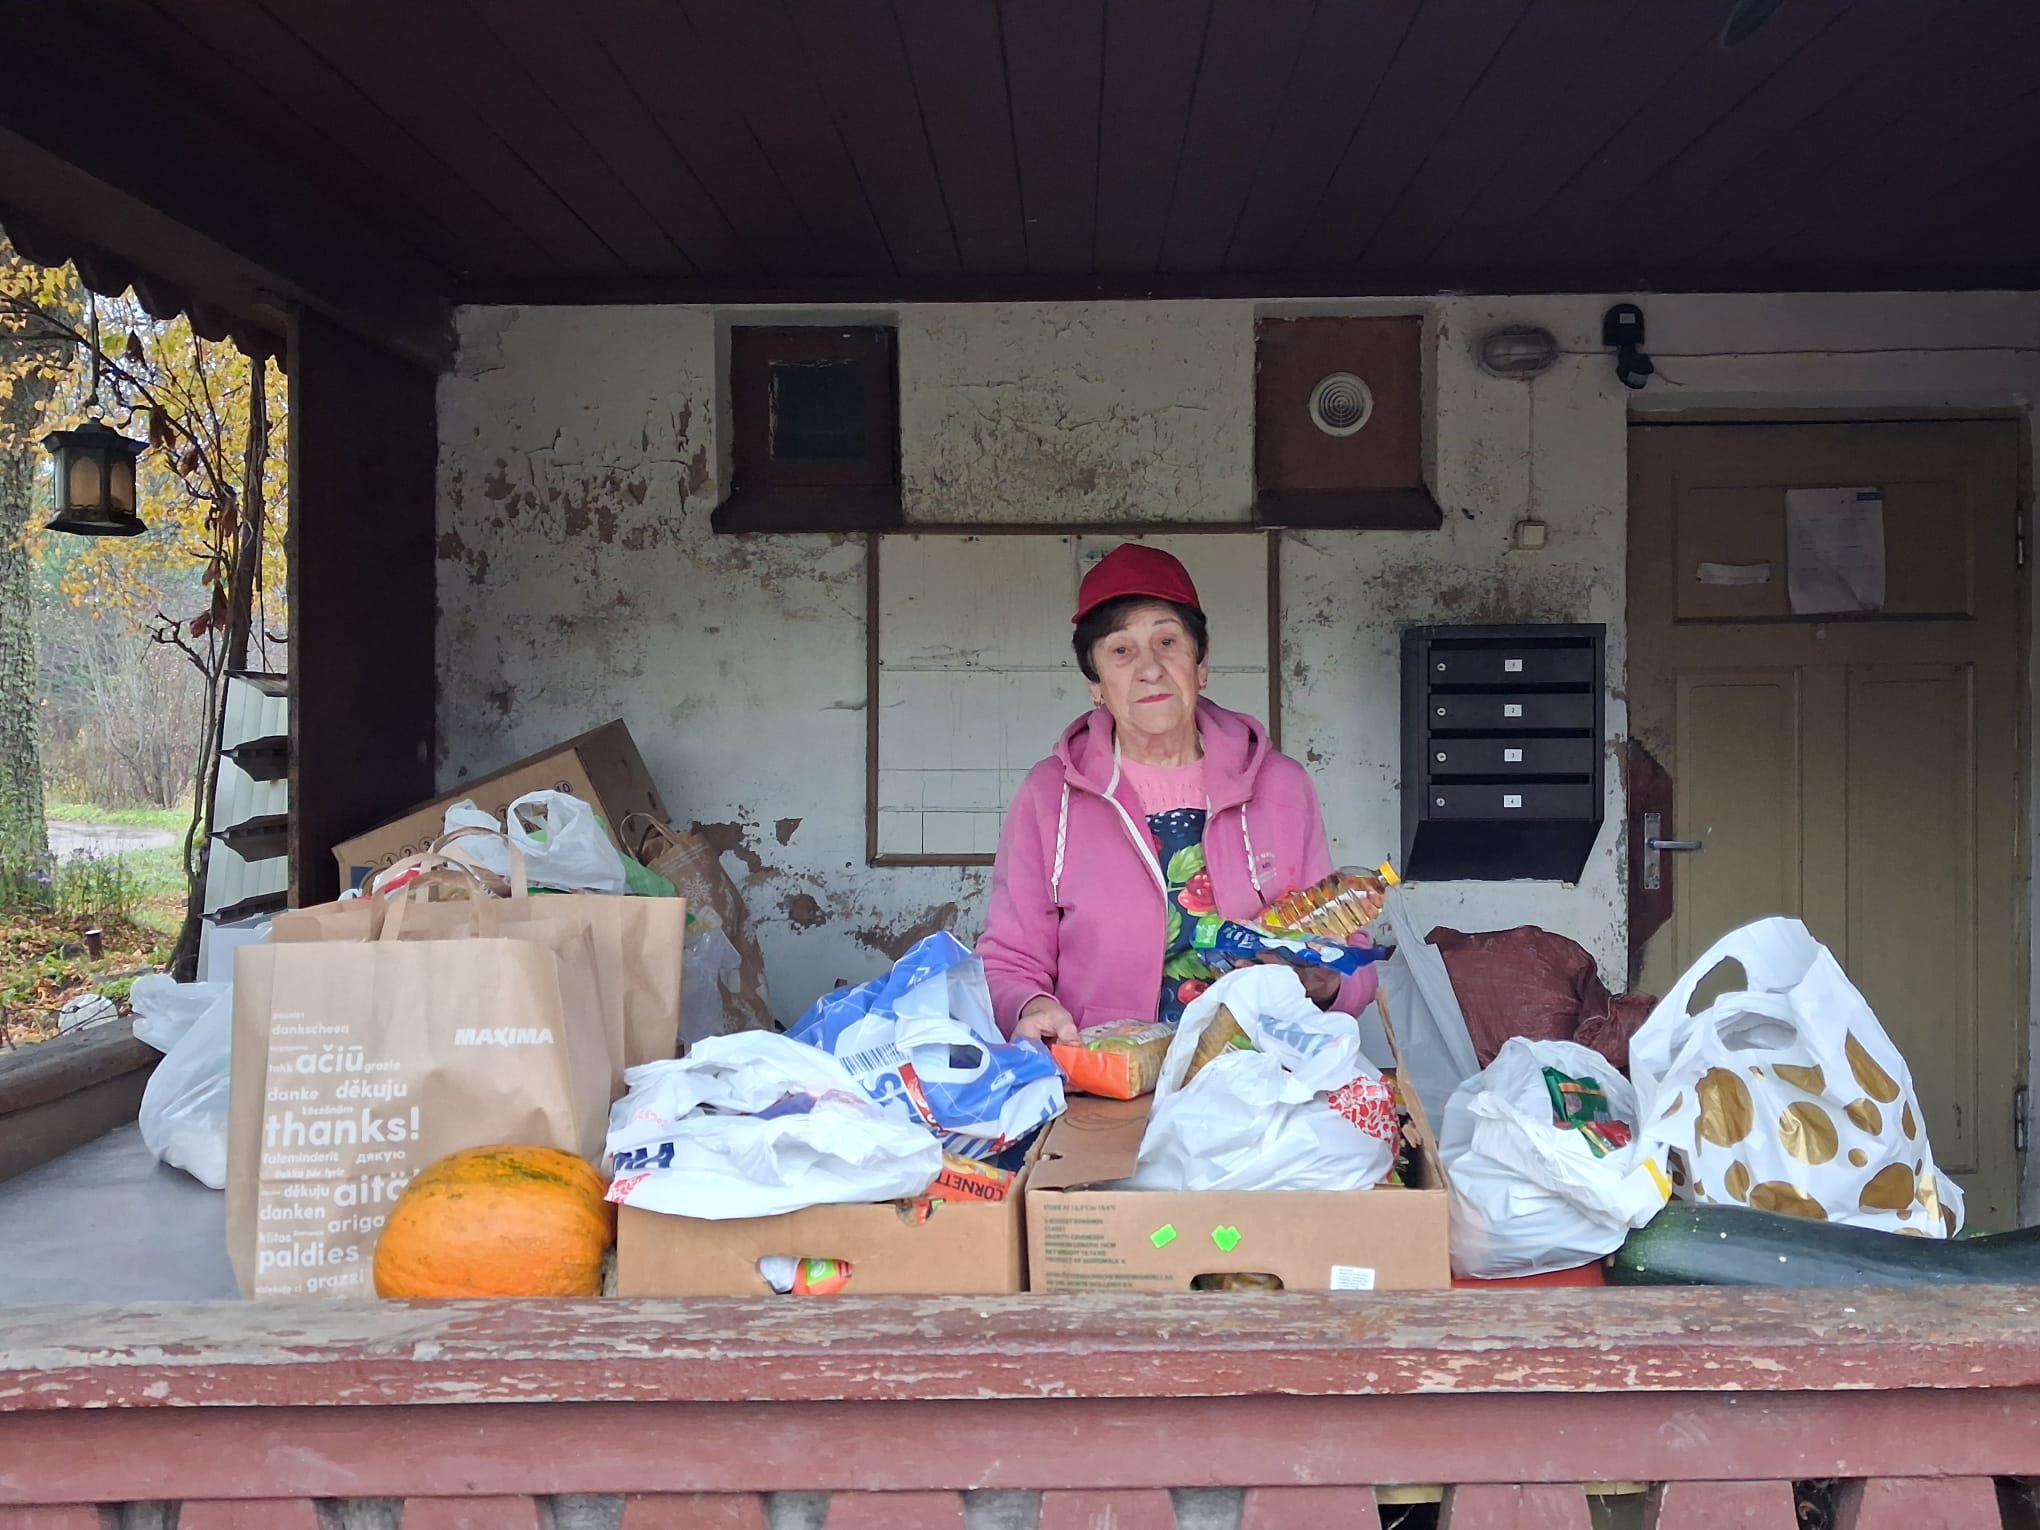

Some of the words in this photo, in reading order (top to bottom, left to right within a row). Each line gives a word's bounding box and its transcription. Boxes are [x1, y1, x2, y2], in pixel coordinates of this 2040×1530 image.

[454, 1026, 554, 1047] MAXIMA
[295, 1044, 365, 1074] ačiū
[266, 1087, 319, 1102] danke
[336, 1079, 408, 1102] děkuju
[265, 1105, 421, 1148] thanks!
[259, 1202, 327, 1221] danken
[258, 1241, 360, 1275] paldies
